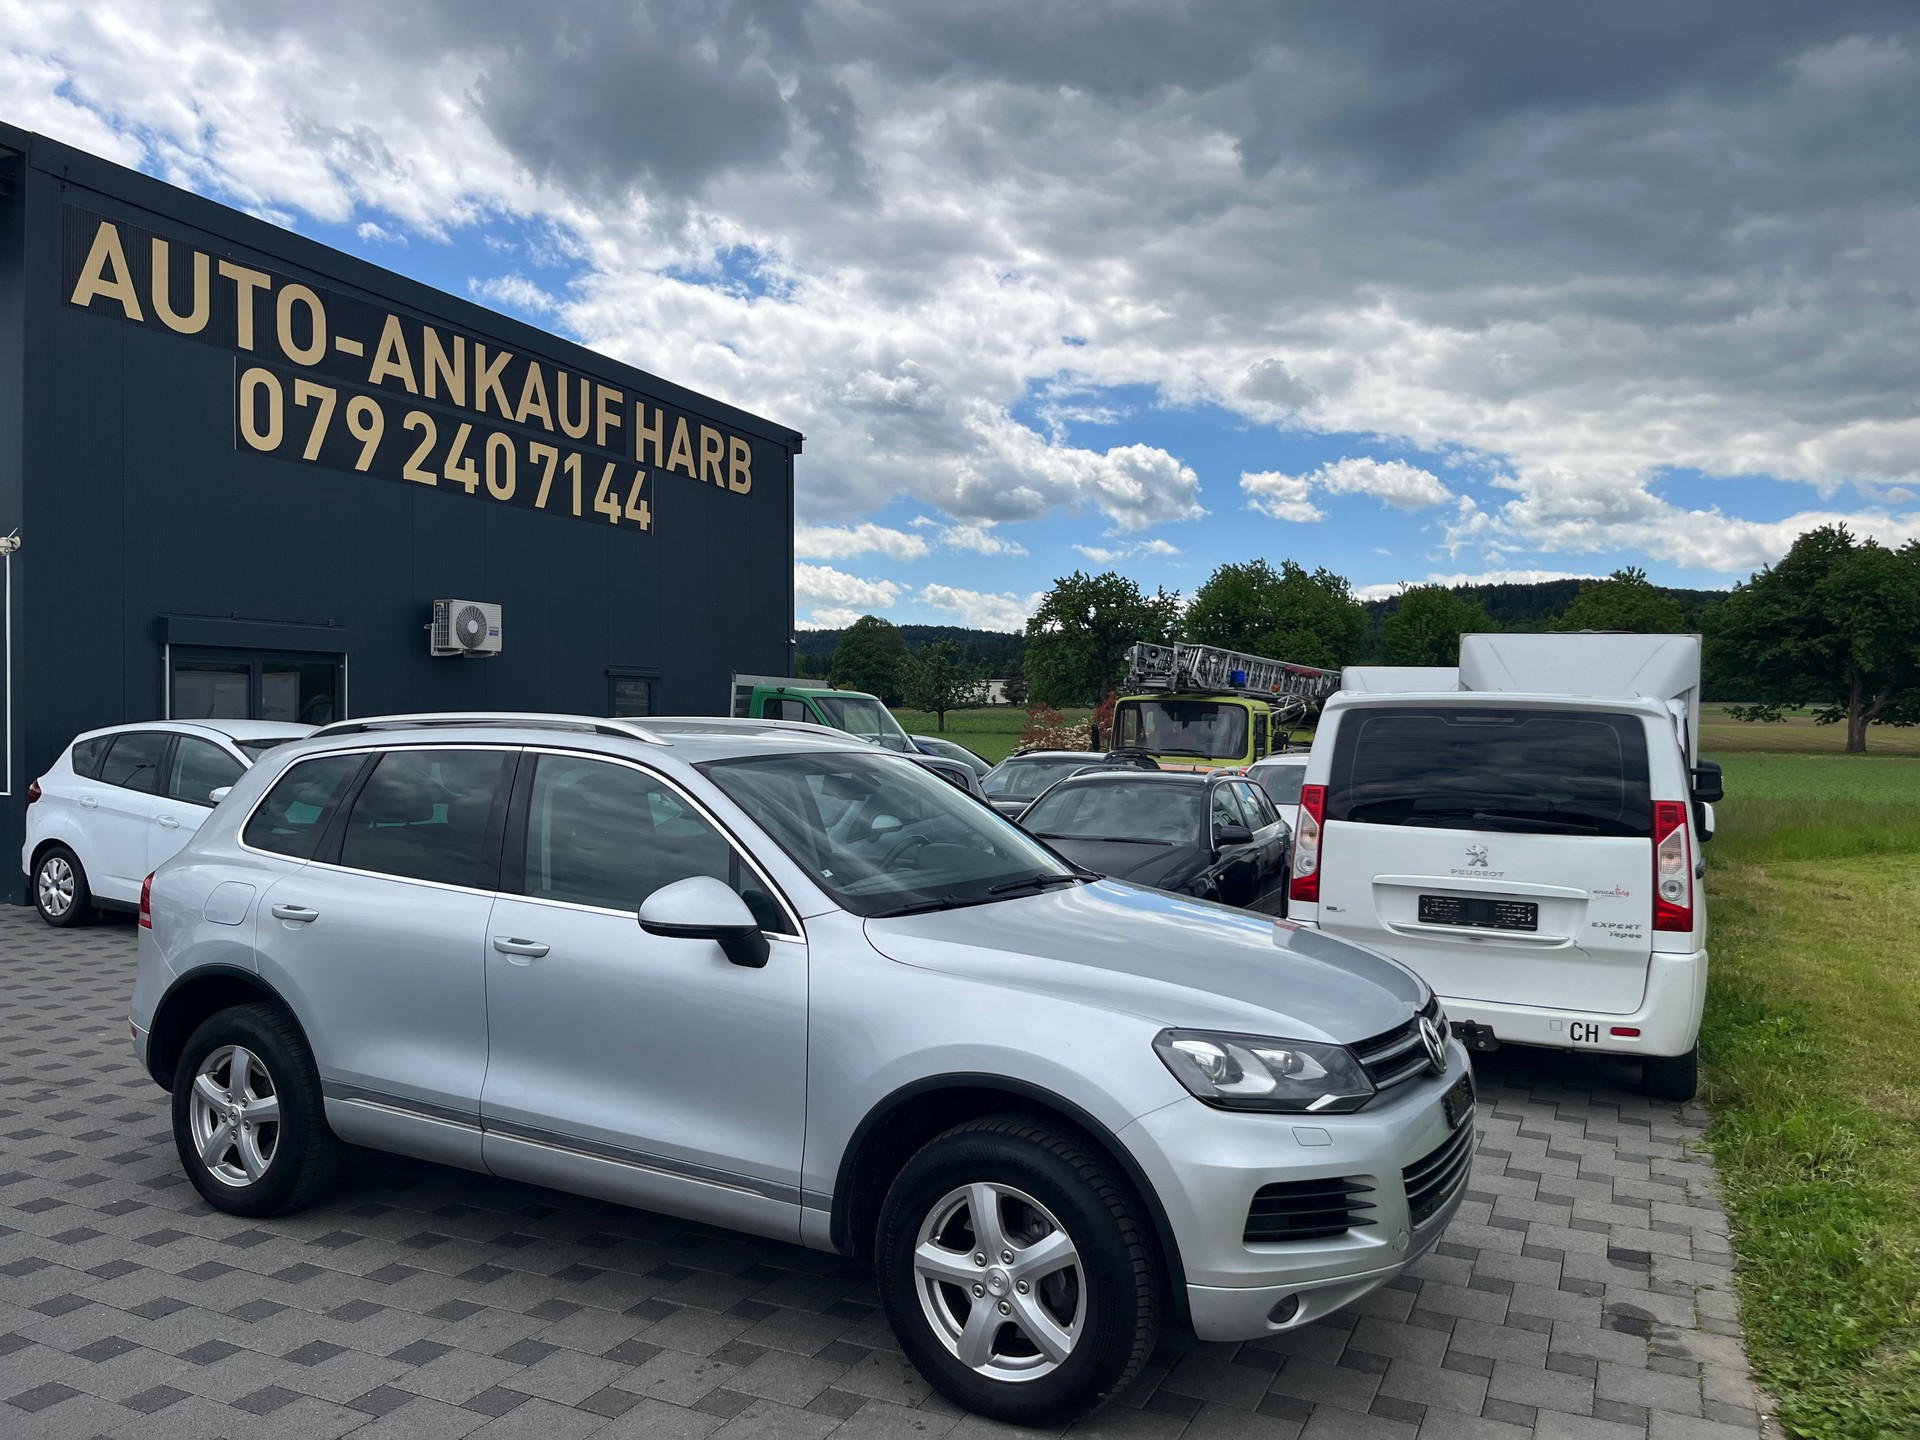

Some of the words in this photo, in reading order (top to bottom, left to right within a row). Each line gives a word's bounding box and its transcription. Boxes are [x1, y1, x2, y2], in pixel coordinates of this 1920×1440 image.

[71, 222, 624, 446] AUTO-ANKAUF
[635, 402, 753, 494] HARB
[239, 367, 385, 472] 079
[402, 411, 517, 502] 240
[1450, 868, 1505, 877] PEUGEOT
[1591, 921, 1642, 930] EXPERT
[1608, 931, 1642, 939] Tepee
[1570, 1022, 1599, 1043] CH
